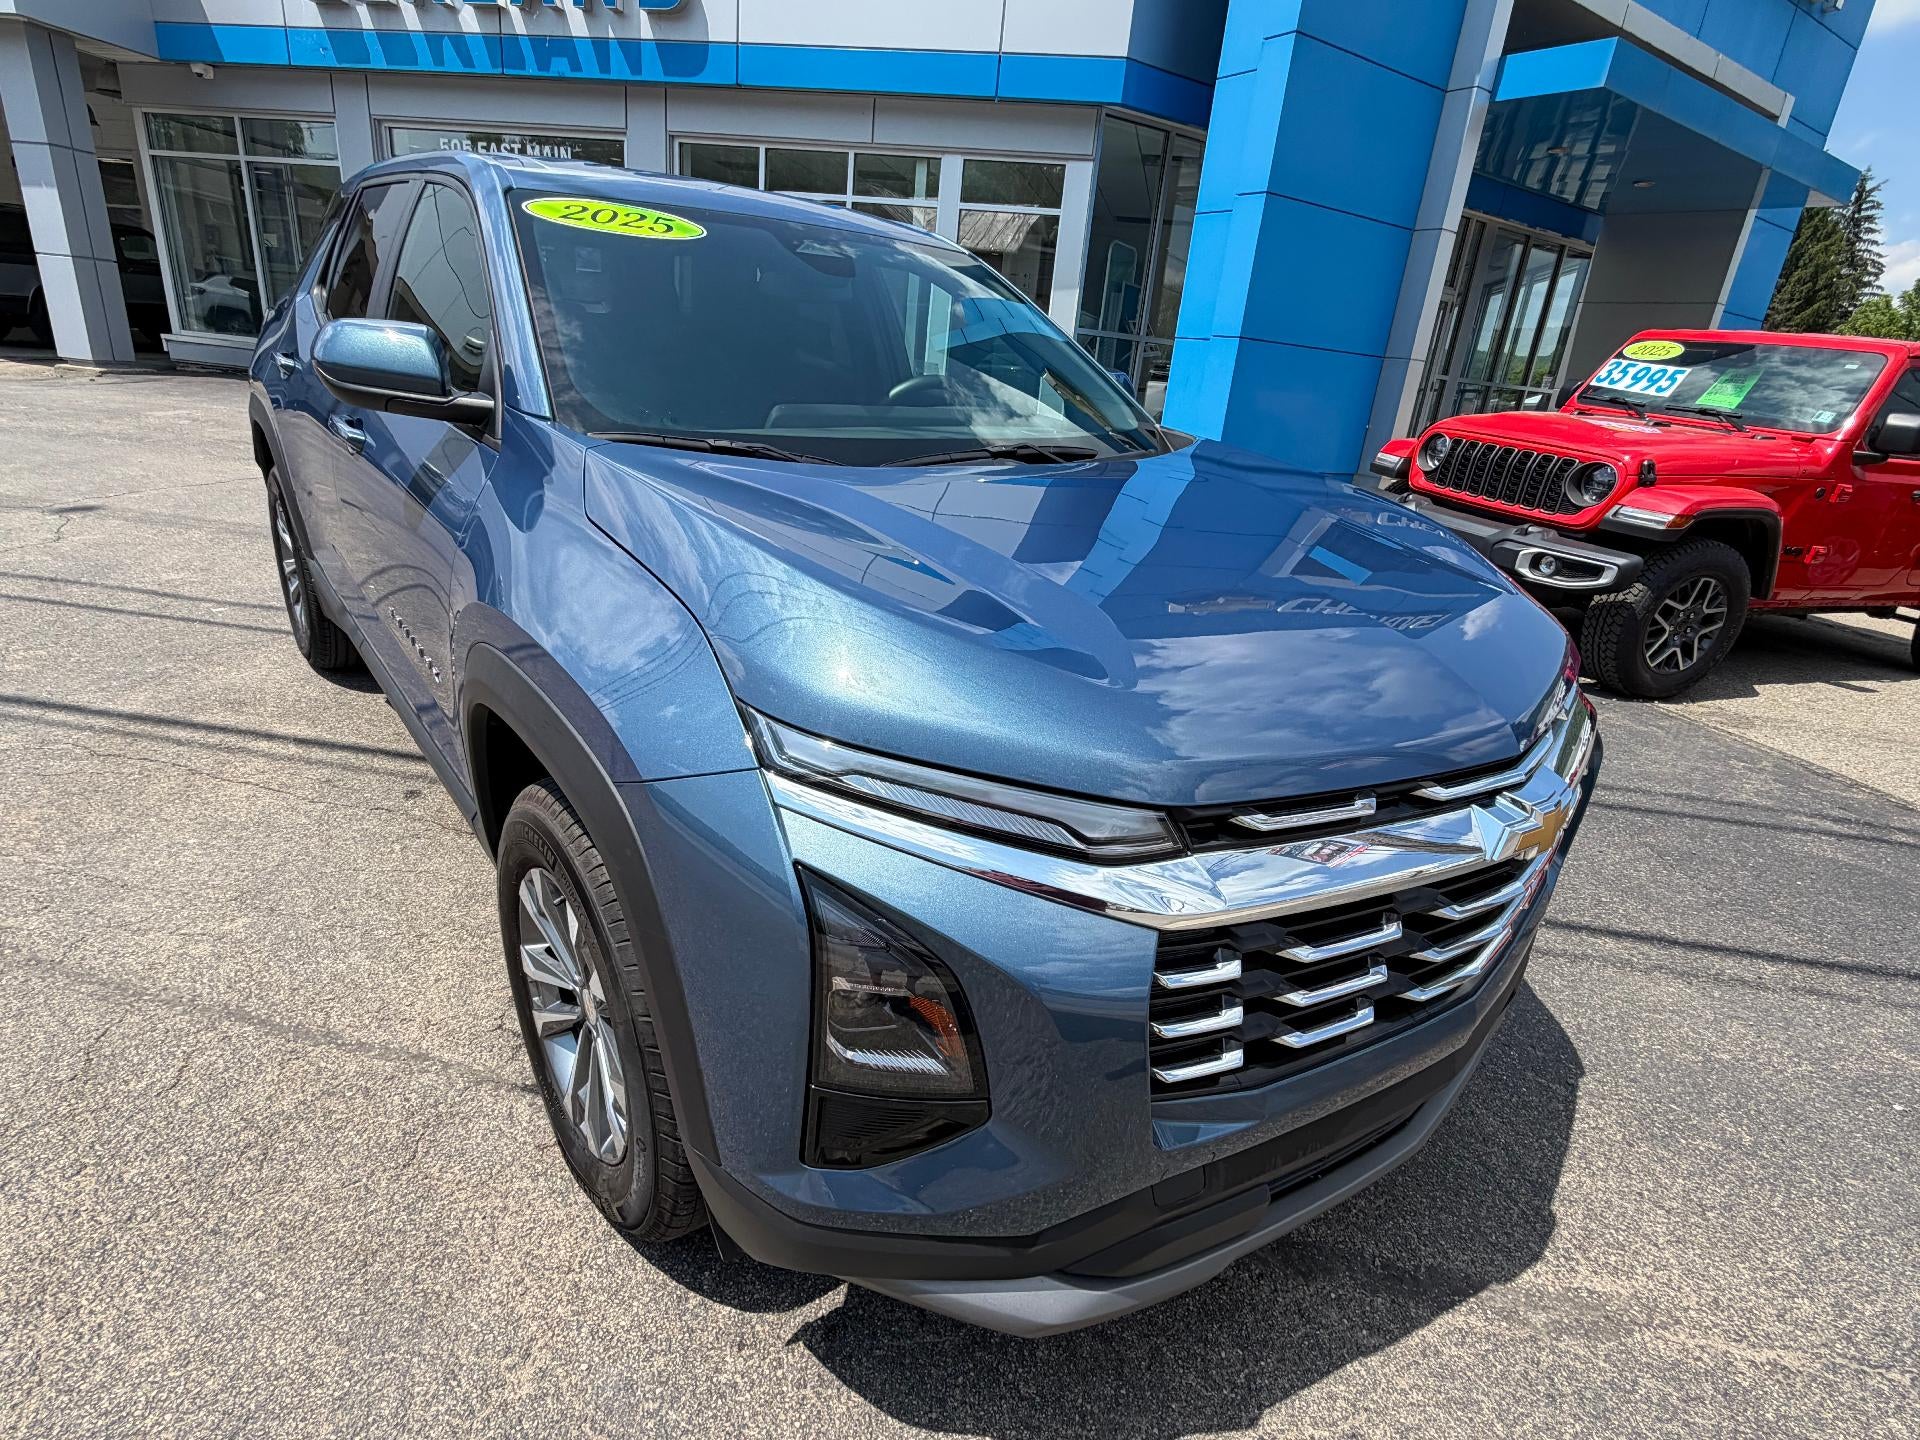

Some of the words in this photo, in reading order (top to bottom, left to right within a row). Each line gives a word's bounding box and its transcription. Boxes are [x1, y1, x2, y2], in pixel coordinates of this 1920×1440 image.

[477, 141, 522, 155] EAST
[526, 144, 572, 160] MAIN
[558, 204, 677, 234] 2025
[1630, 344, 1677, 357] 2025
[1595, 360, 1688, 394] 35995
